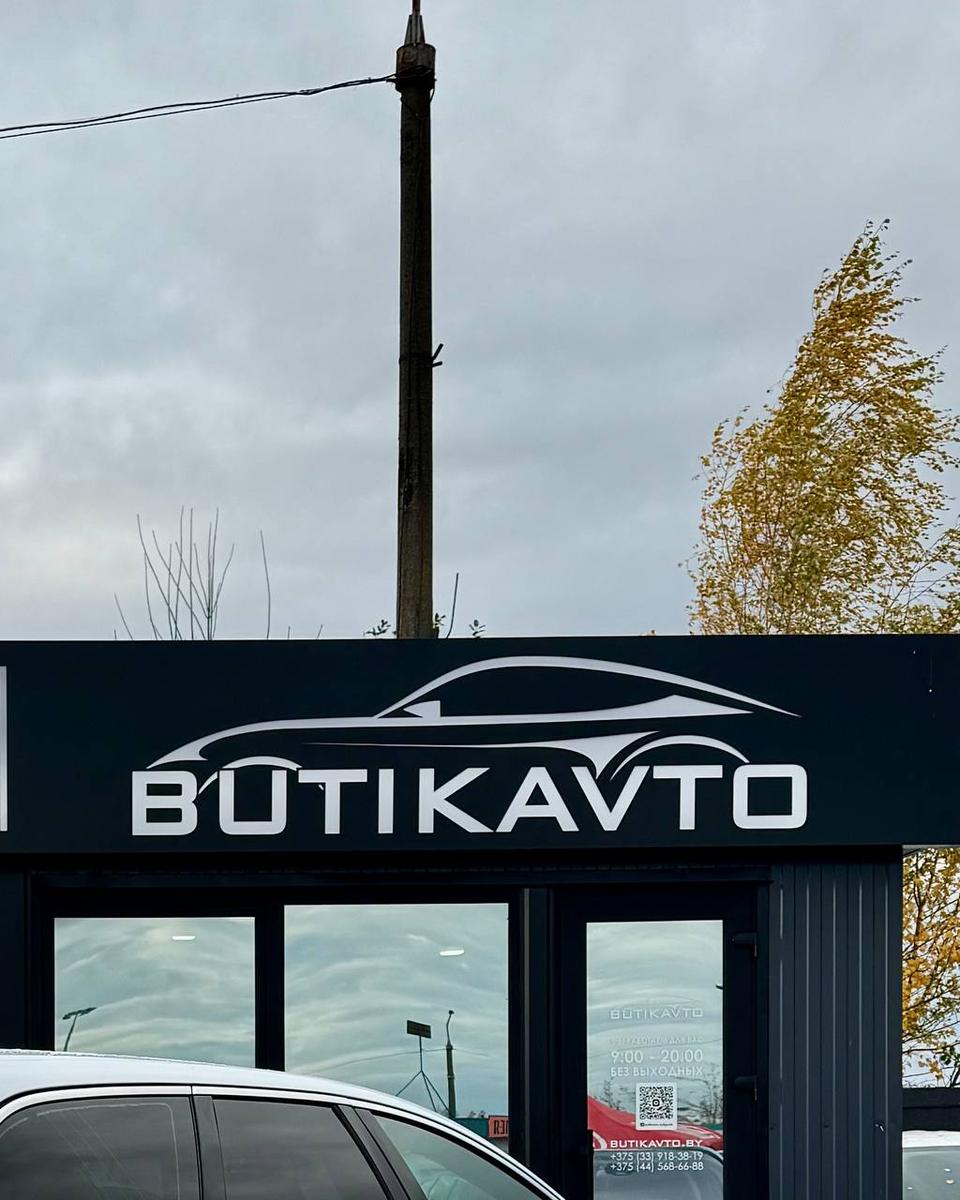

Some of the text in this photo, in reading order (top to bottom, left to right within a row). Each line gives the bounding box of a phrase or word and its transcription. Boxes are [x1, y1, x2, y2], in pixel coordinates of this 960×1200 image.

[132, 763, 807, 836] BUTIKAVTO
[610, 1007, 704, 1020] BUTIKAVTO
[611, 1050, 644, 1064] 9:00
[660, 1049, 703, 1063] 20:00
[610, 1066, 703, 1077] БЕЗ ВЫХОДНЫХ
[610, 1139, 704, 1148] BUTIKAVTO.BY
[610, 1152, 704, 1163] +375 (33) 918-38-19
[610, 1162, 704, 1173] +375 (44) 568-66-88
